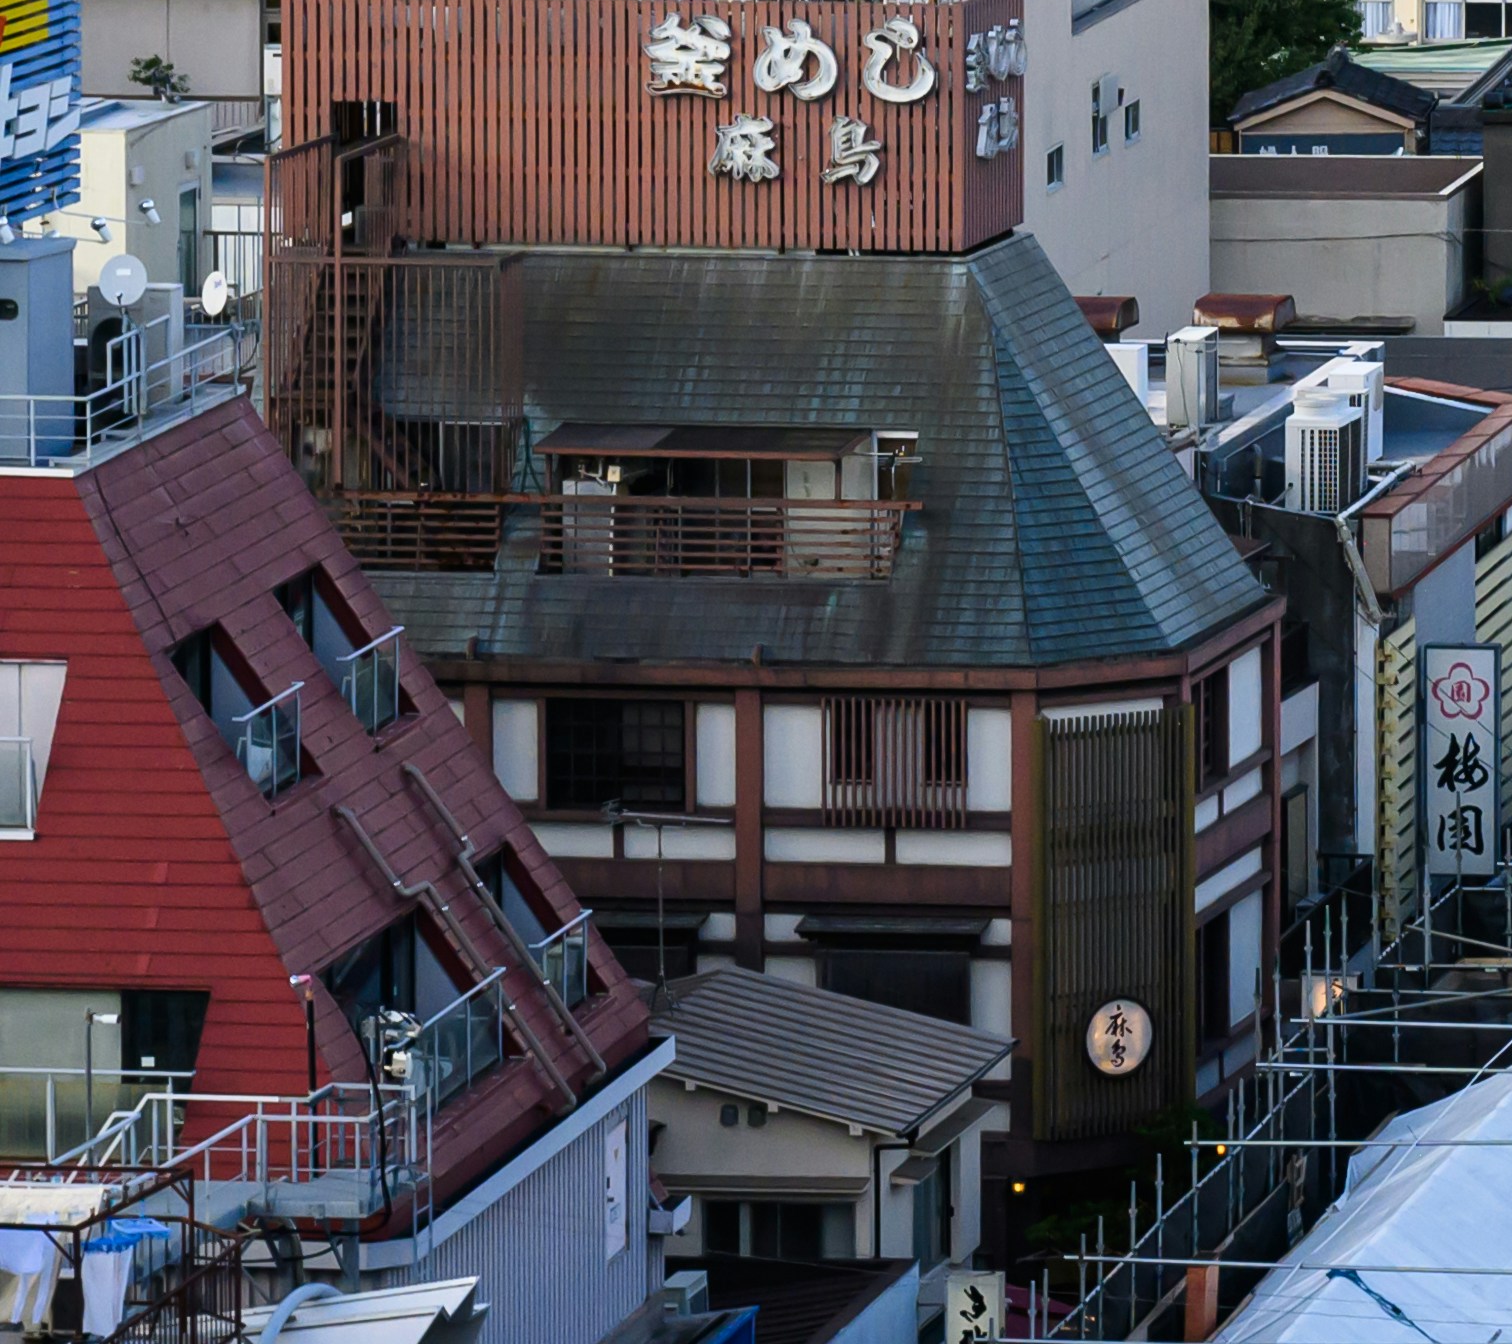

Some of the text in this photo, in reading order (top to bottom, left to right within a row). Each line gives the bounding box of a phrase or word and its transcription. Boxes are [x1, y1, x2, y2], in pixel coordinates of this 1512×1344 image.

[643, 12, 936, 103] 釜めし
[707, 112, 883, 187] 麻鳥
[1433, 731, 1490, 856] 梅園
